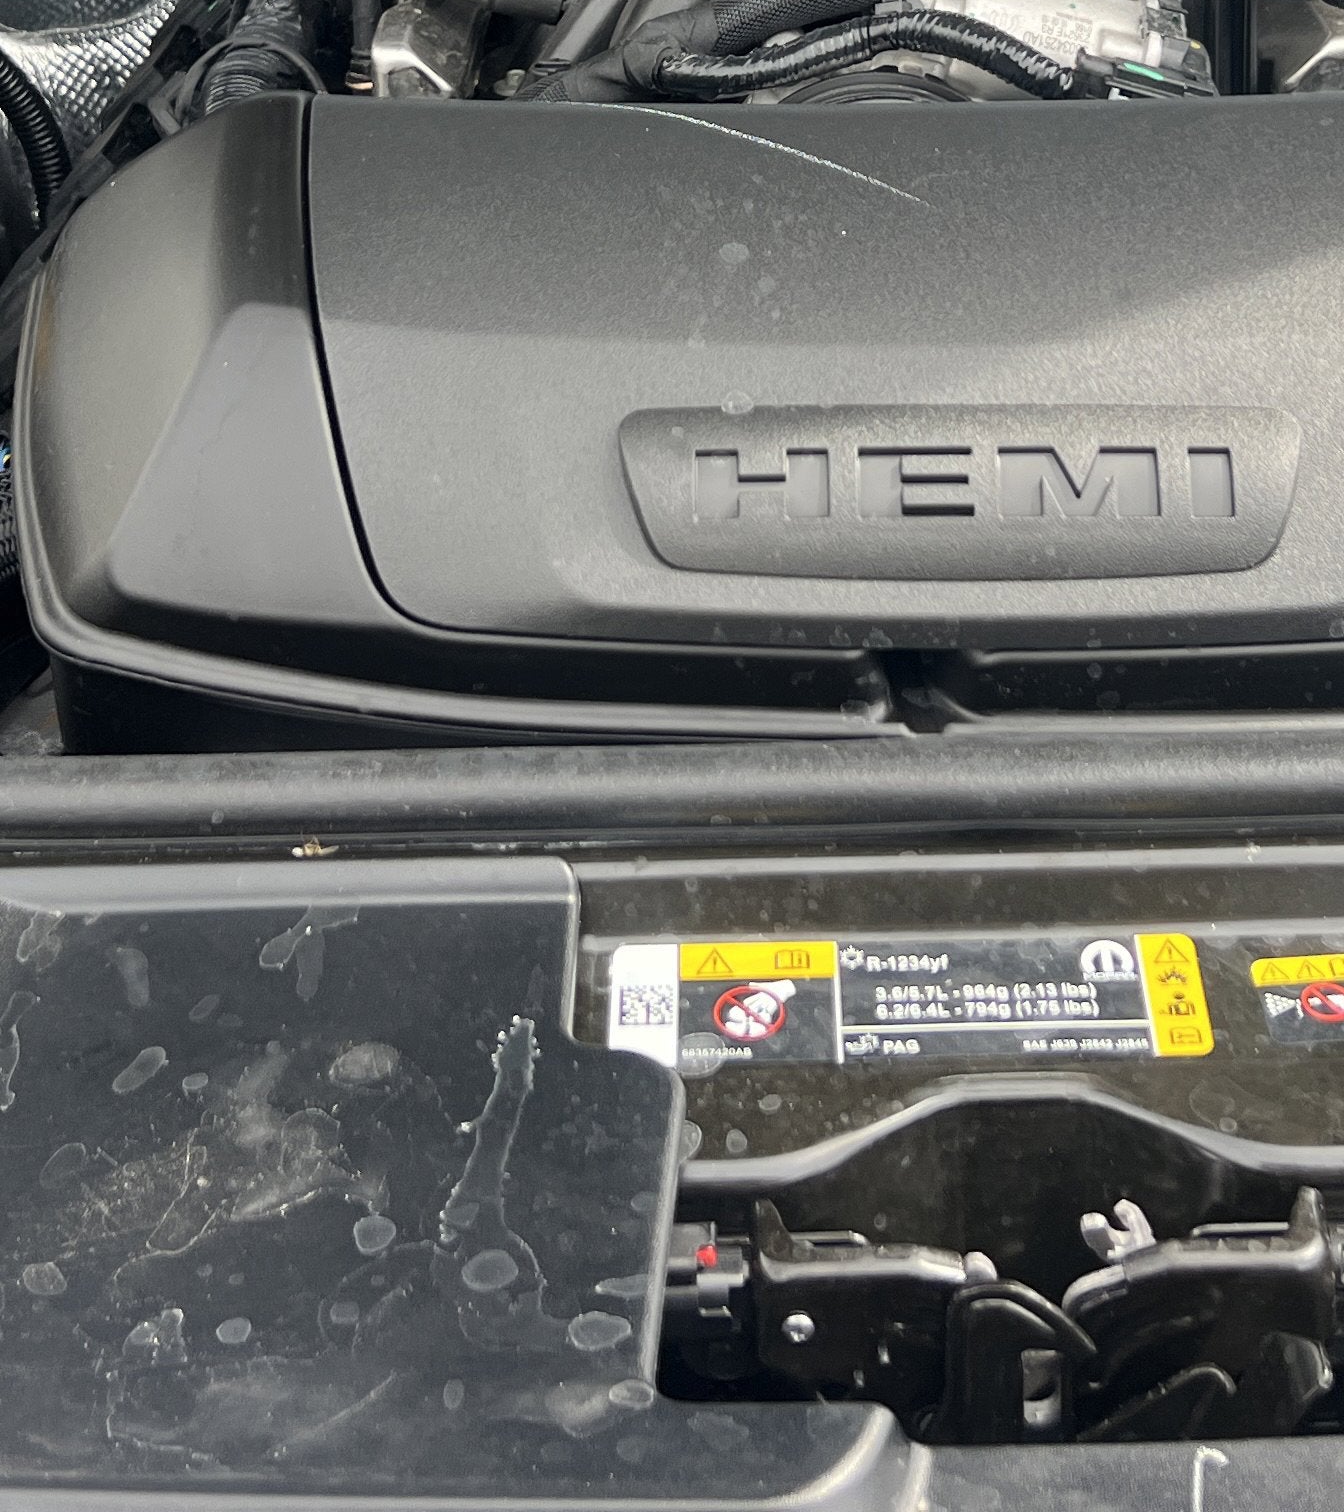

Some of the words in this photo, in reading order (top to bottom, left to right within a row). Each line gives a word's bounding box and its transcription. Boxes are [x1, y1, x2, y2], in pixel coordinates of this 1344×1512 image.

[693, 446, 1236, 519] HEMI
[866, 953, 949, 973] R-1234yf
[1061, 982, 1097, 1000] lbs)
[1064, 999, 1100, 1018] lbs)
[883, 1038, 920, 1055] PAG
